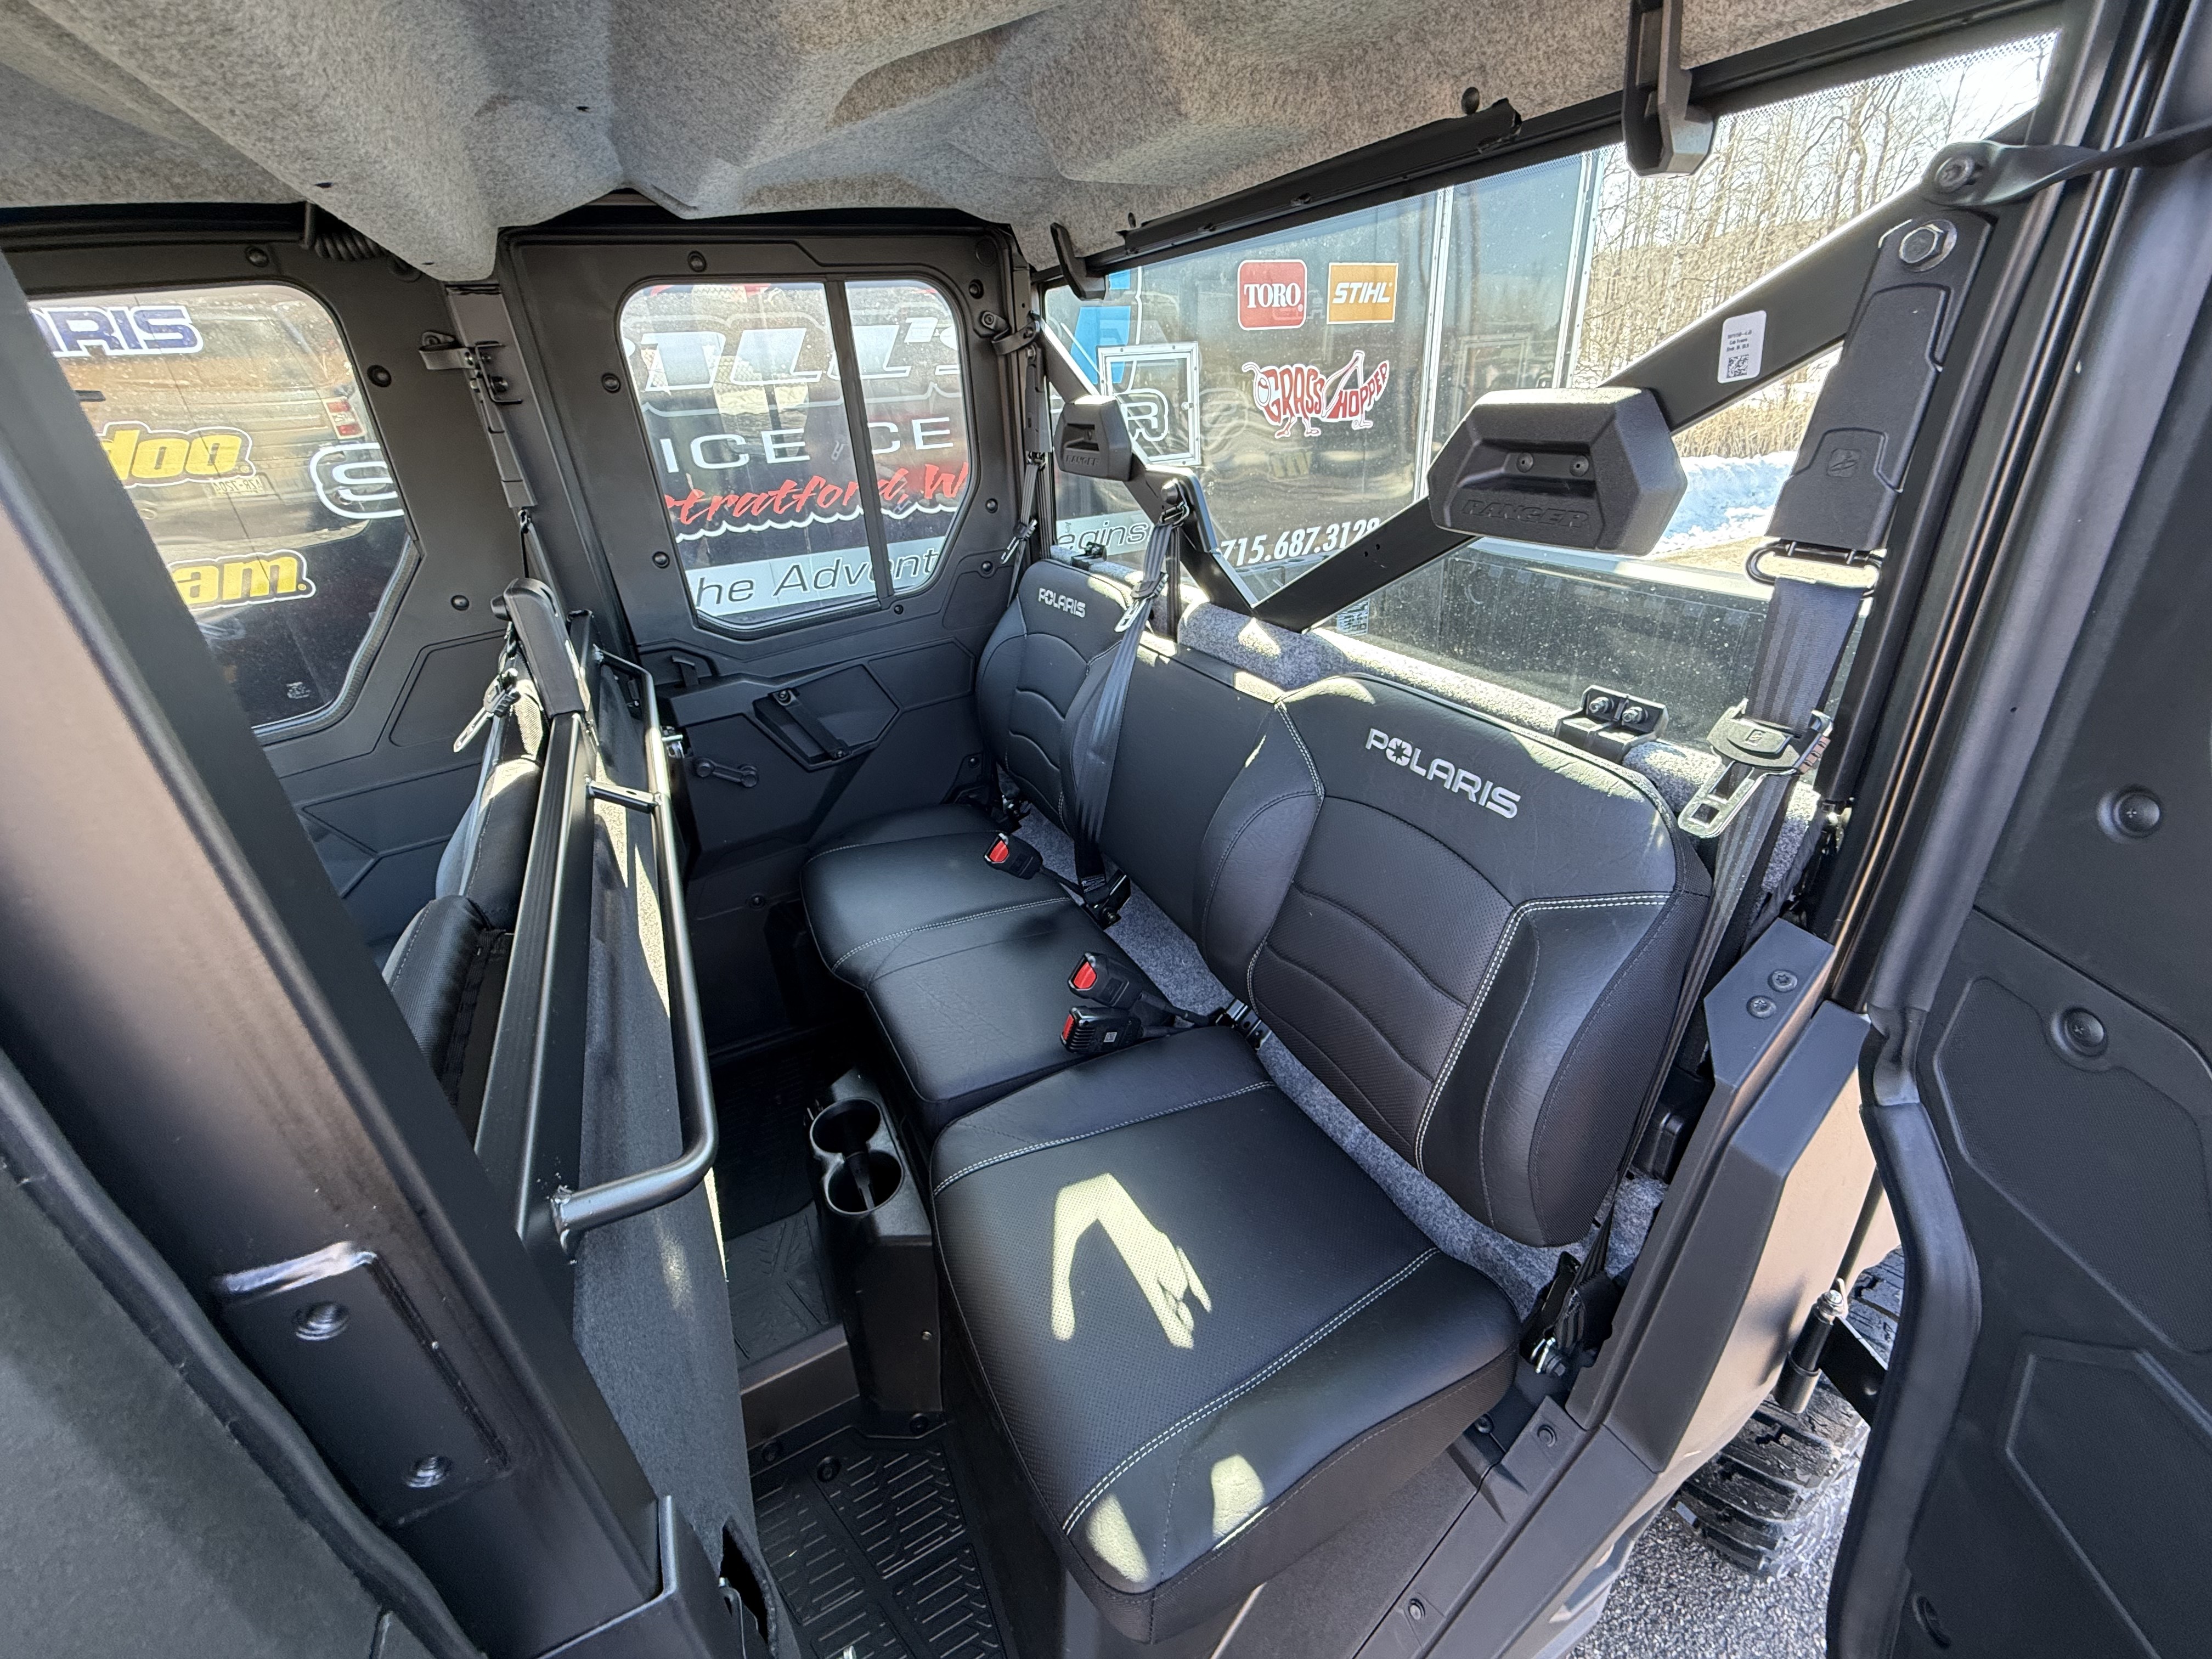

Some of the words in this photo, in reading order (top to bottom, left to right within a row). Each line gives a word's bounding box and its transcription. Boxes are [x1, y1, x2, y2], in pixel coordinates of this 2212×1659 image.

[1244, 282, 1301, 308] TORO
[1332, 282, 1391, 304] STIHL
[1462, 499, 1589, 528] RANGER
[1038, 588, 1086, 618] POLARIS
[1365, 727, 1521, 819] POLARIS
